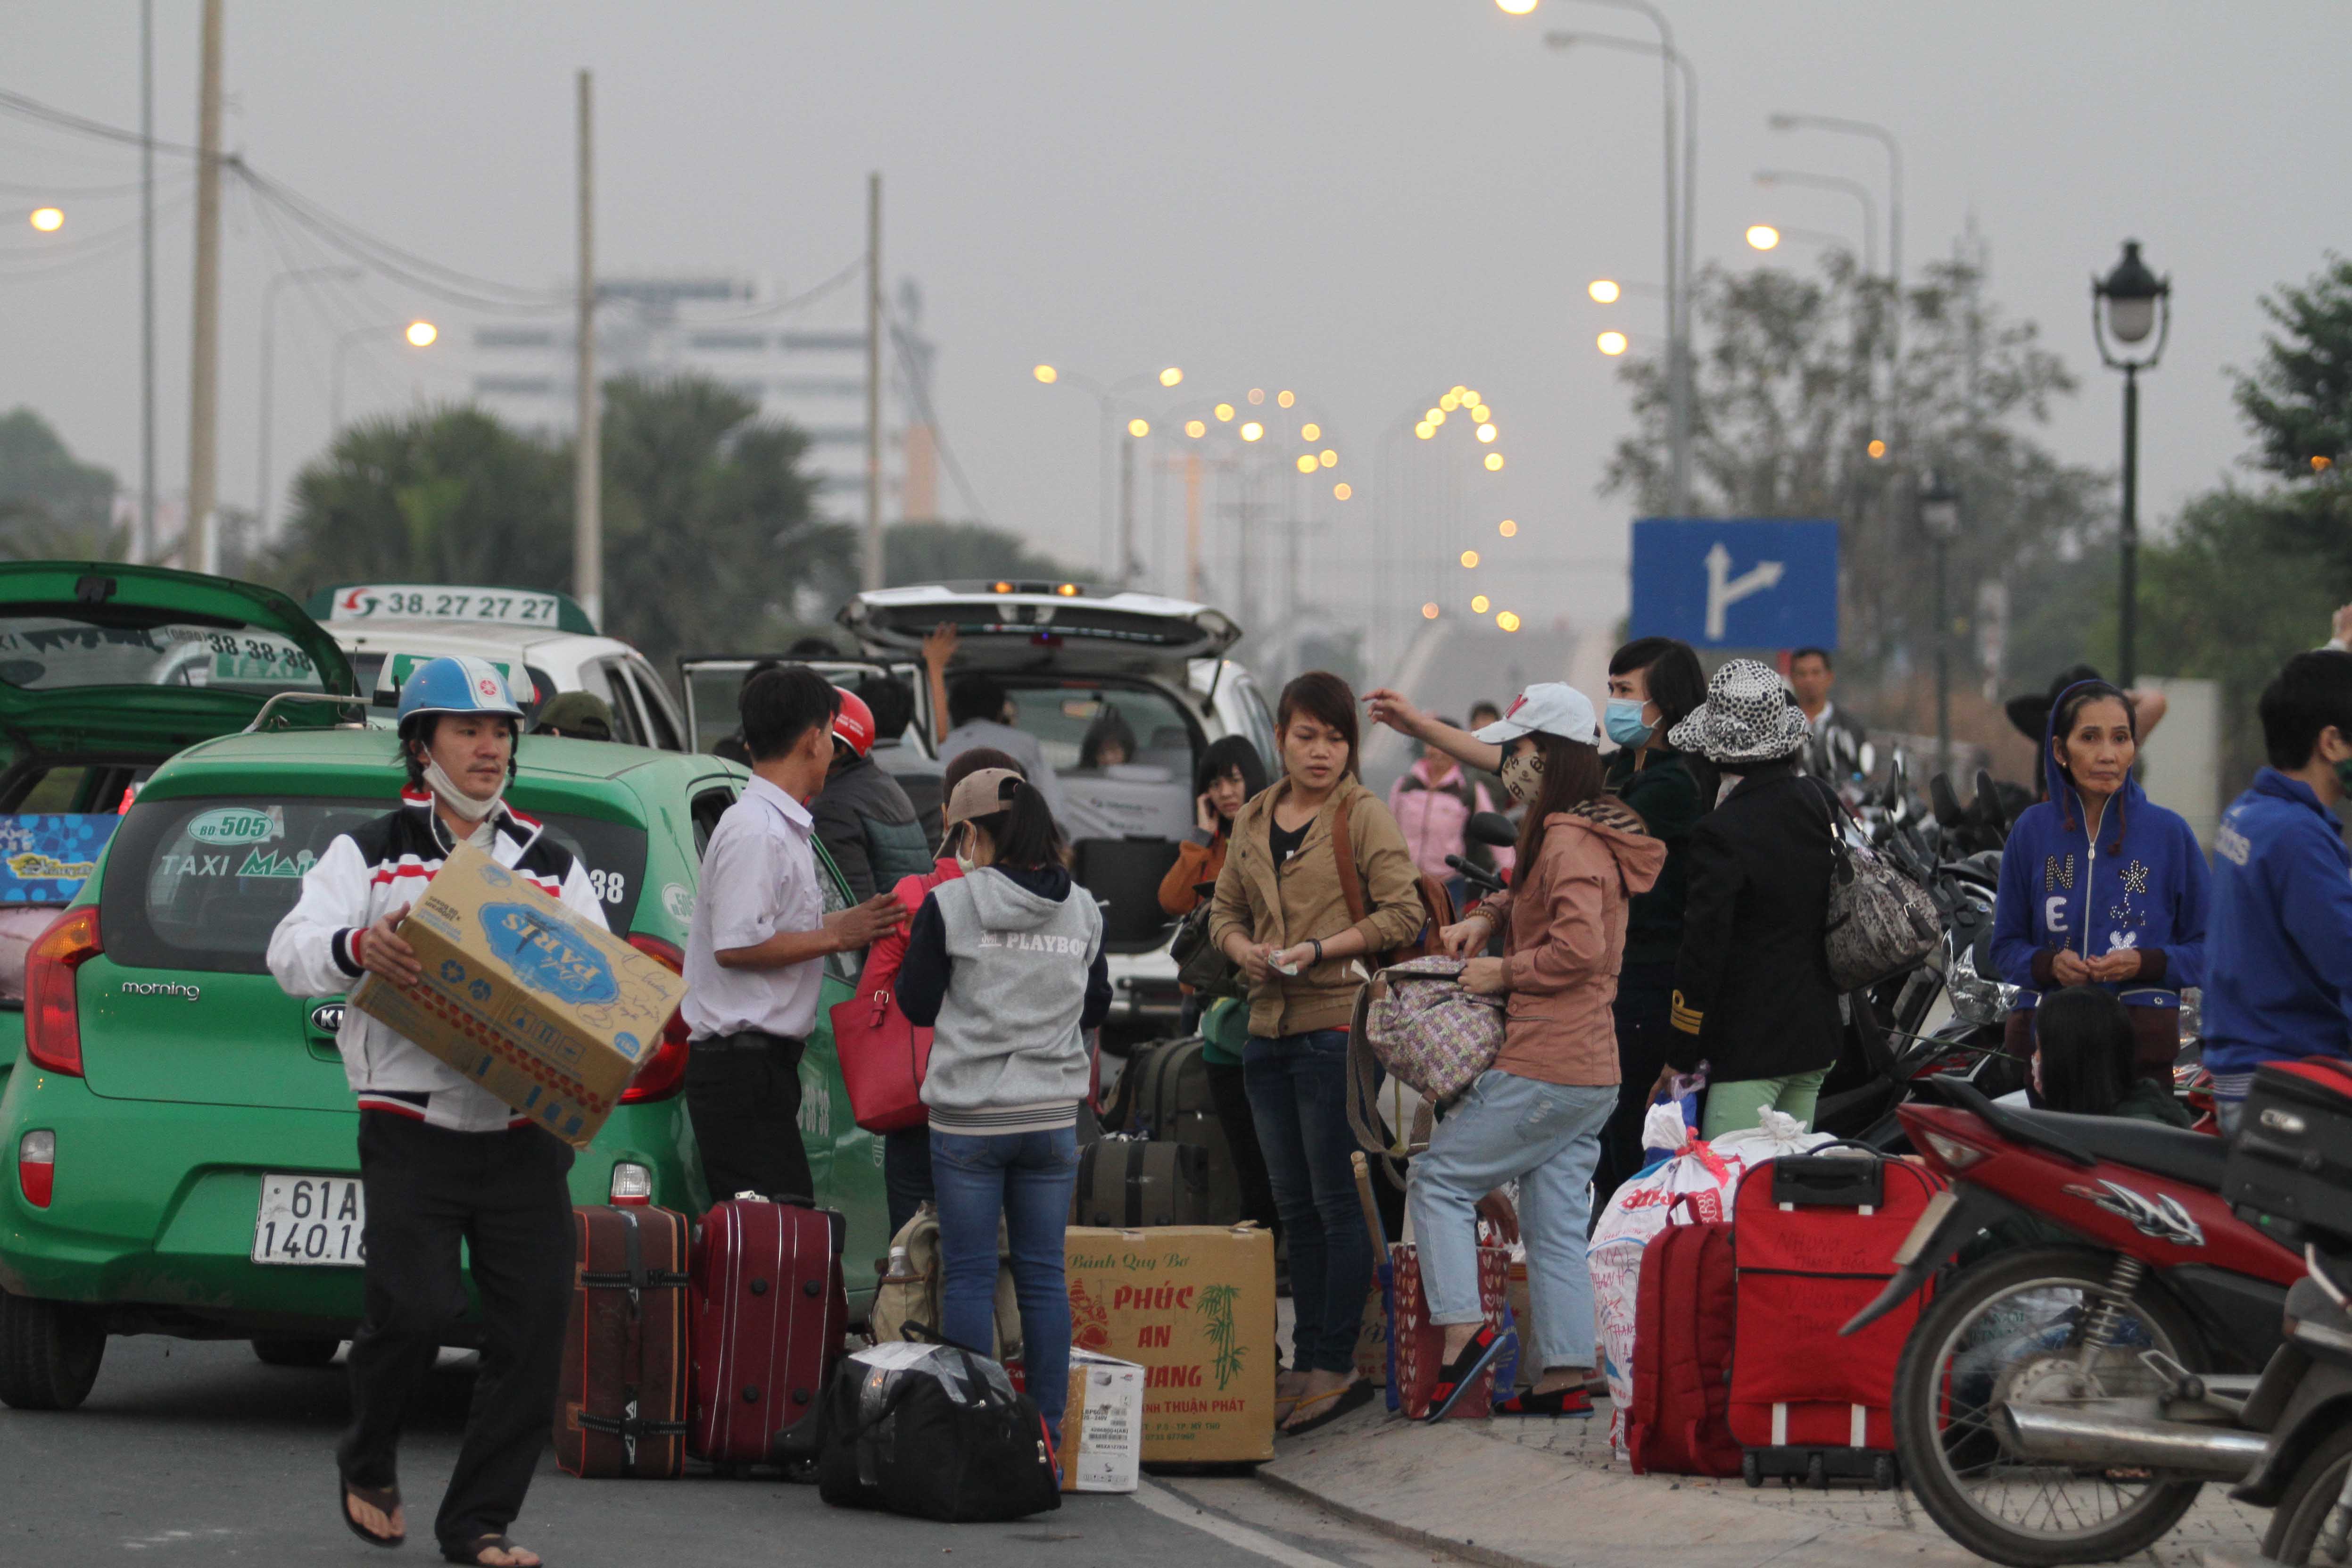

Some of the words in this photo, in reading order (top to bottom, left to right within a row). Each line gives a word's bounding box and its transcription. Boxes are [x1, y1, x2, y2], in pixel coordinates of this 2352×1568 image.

[479, 597, 512, 616] 27
[521, 599, 554, 619] 27
[207, 633, 239, 655] 38
[245, 639, 276, 663] 38
[283, 647, 313, 672] 38
[219, 816, 268, 837] 505
[162, 855, 230, 876] TAXI
[590, 869, 624, 904] 38
[500, 912, 601, 981] PARIS
[122, 981, 200, 1001] morning
[321, 1009, 343, 1027] KI
[292, 1180, 356, 1221] 61A
[1067, 1253, 1116, 1269] Bánh
[1123, 1253, 1157, 1271] Quy
[1113, 1279, 1194, 1310] PHÚC
[1137, 1325, 1172, 1348] AN
[1143, 1365, 1202, 1388] HANG
[1164, 1397, 1207, 1414] THUẬN
[1212, 1397, 1245, 1411] PHÁT
